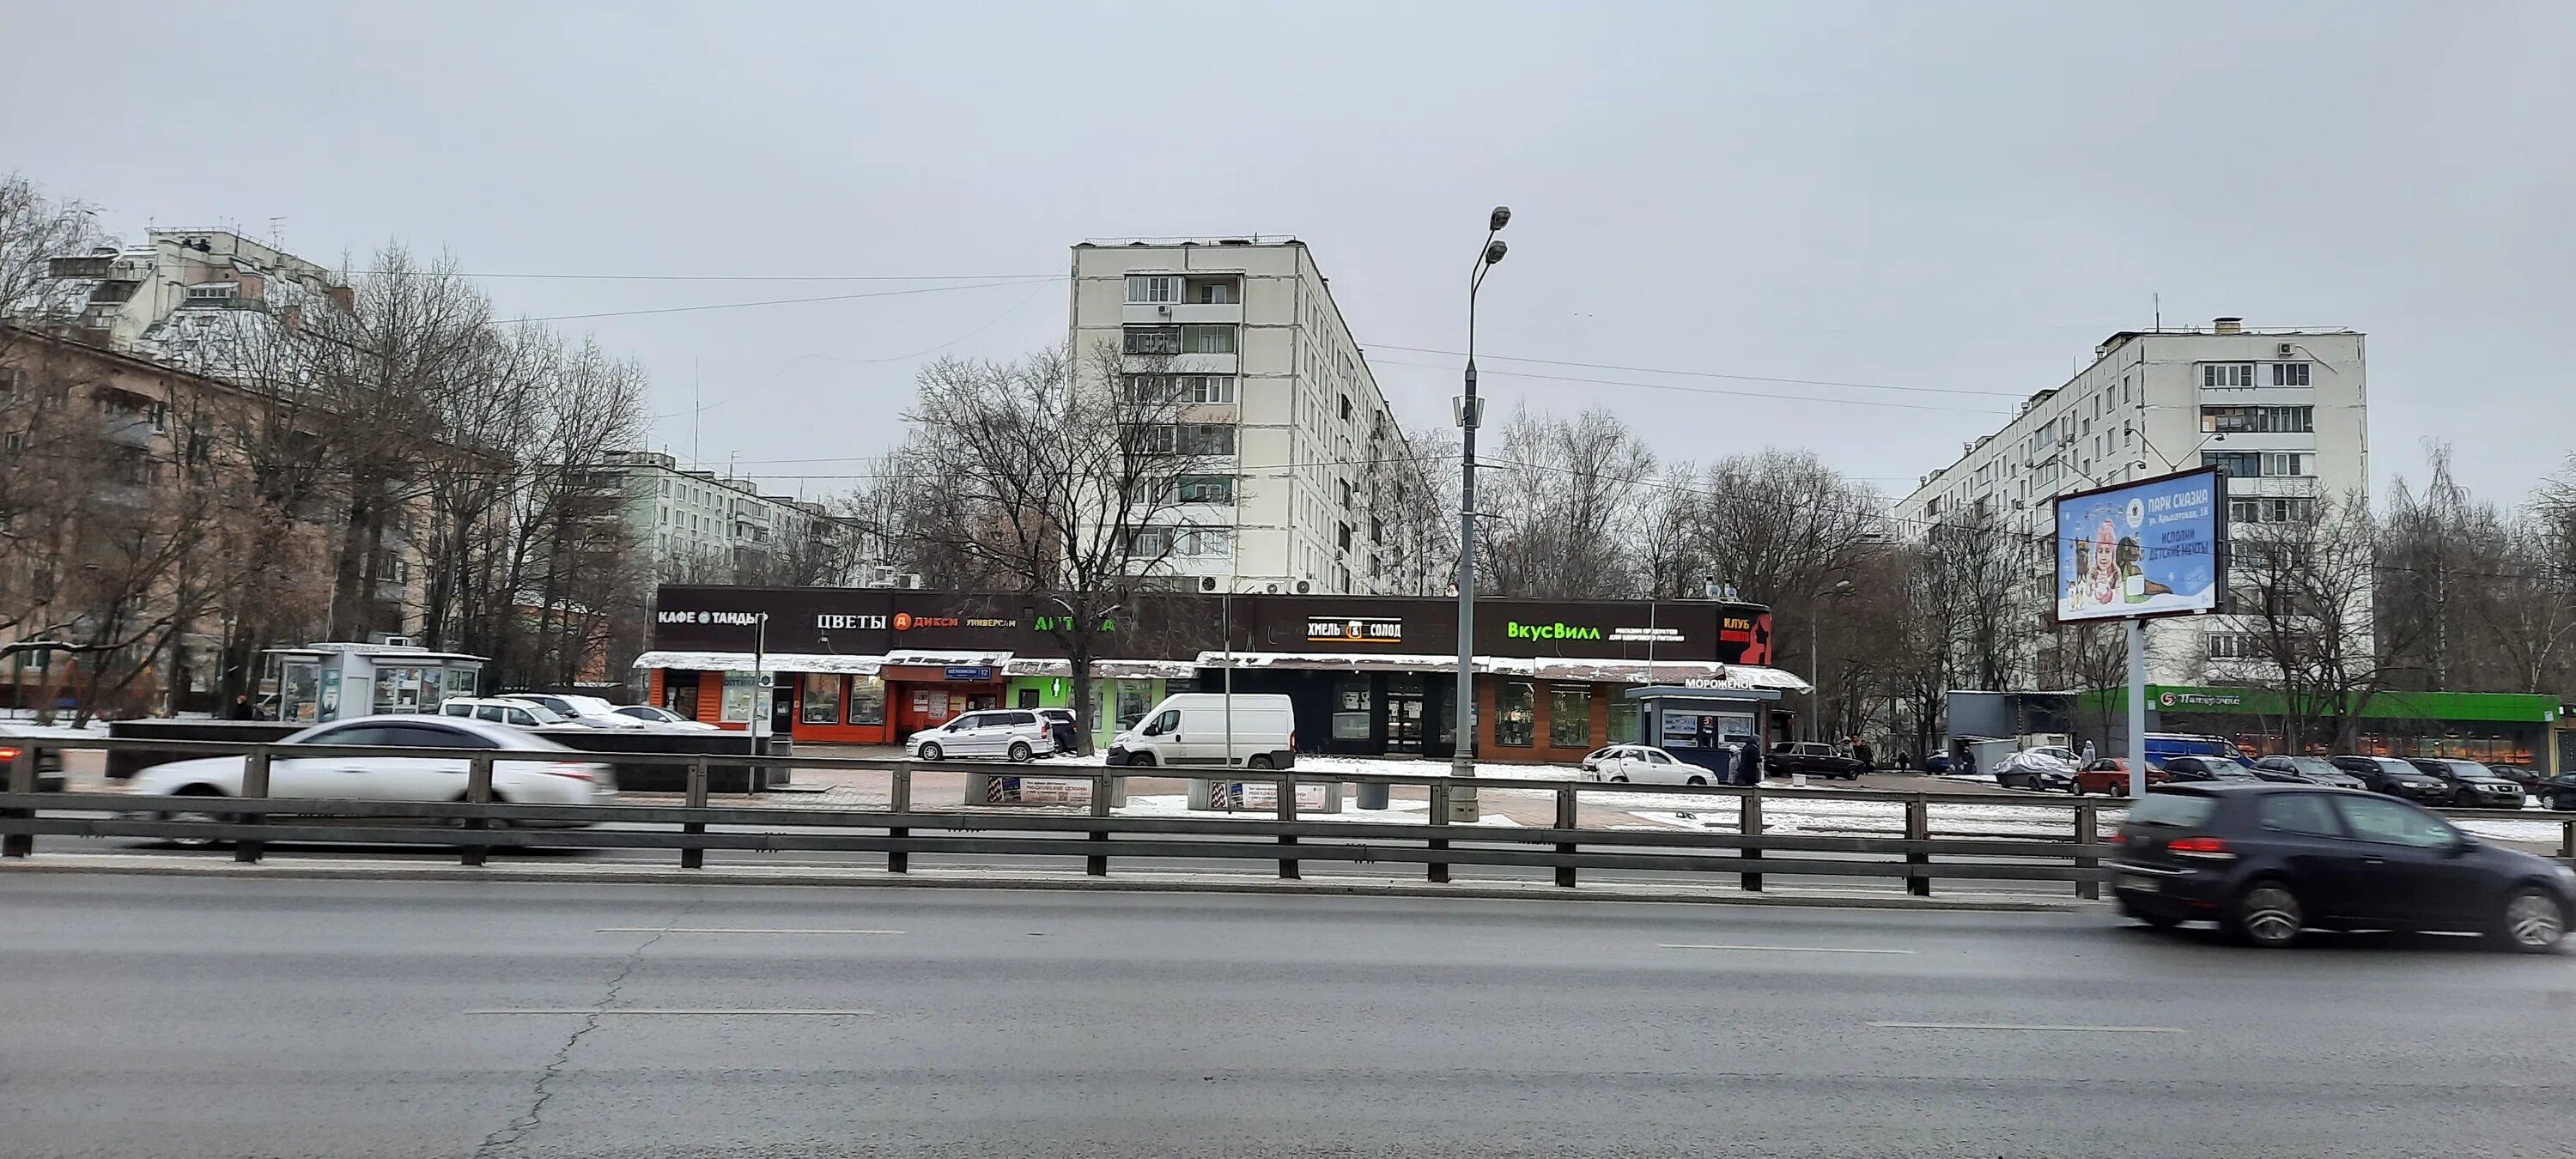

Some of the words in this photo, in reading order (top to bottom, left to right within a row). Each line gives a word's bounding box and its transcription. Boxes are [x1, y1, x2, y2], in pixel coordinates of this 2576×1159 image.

[2148, 495, 2171, 513] ПАРК
[2173, 488, 2208, 508] СКАЗКА
[2200, 506, 2208, 516] 18
[2162, 528, 2195, 543] ИСПОЛНИ
[2149, 544, 2180, 561] ДЕТСКИЕ
[2182, 541, 2208, 556] МЕЧТЫ
[658, 611, 696, 623] КАФЕ
[817, 614, 887, 629] ЦВЕТЫ
[913, 616, 958, 628] ДИКСИ
[966, 618, 1016, 628] УНИВЕРСАМ
[1034, 616, 1115, 631] АТА
[1723, 617, 1750, 629] КЛУБ
[1308, 622, 1340, 636] ХМЕЛЬ
[1370, 623, 1401, 638] СОЛОД
[1508, 621, 1601, 642] ВкусВилл
